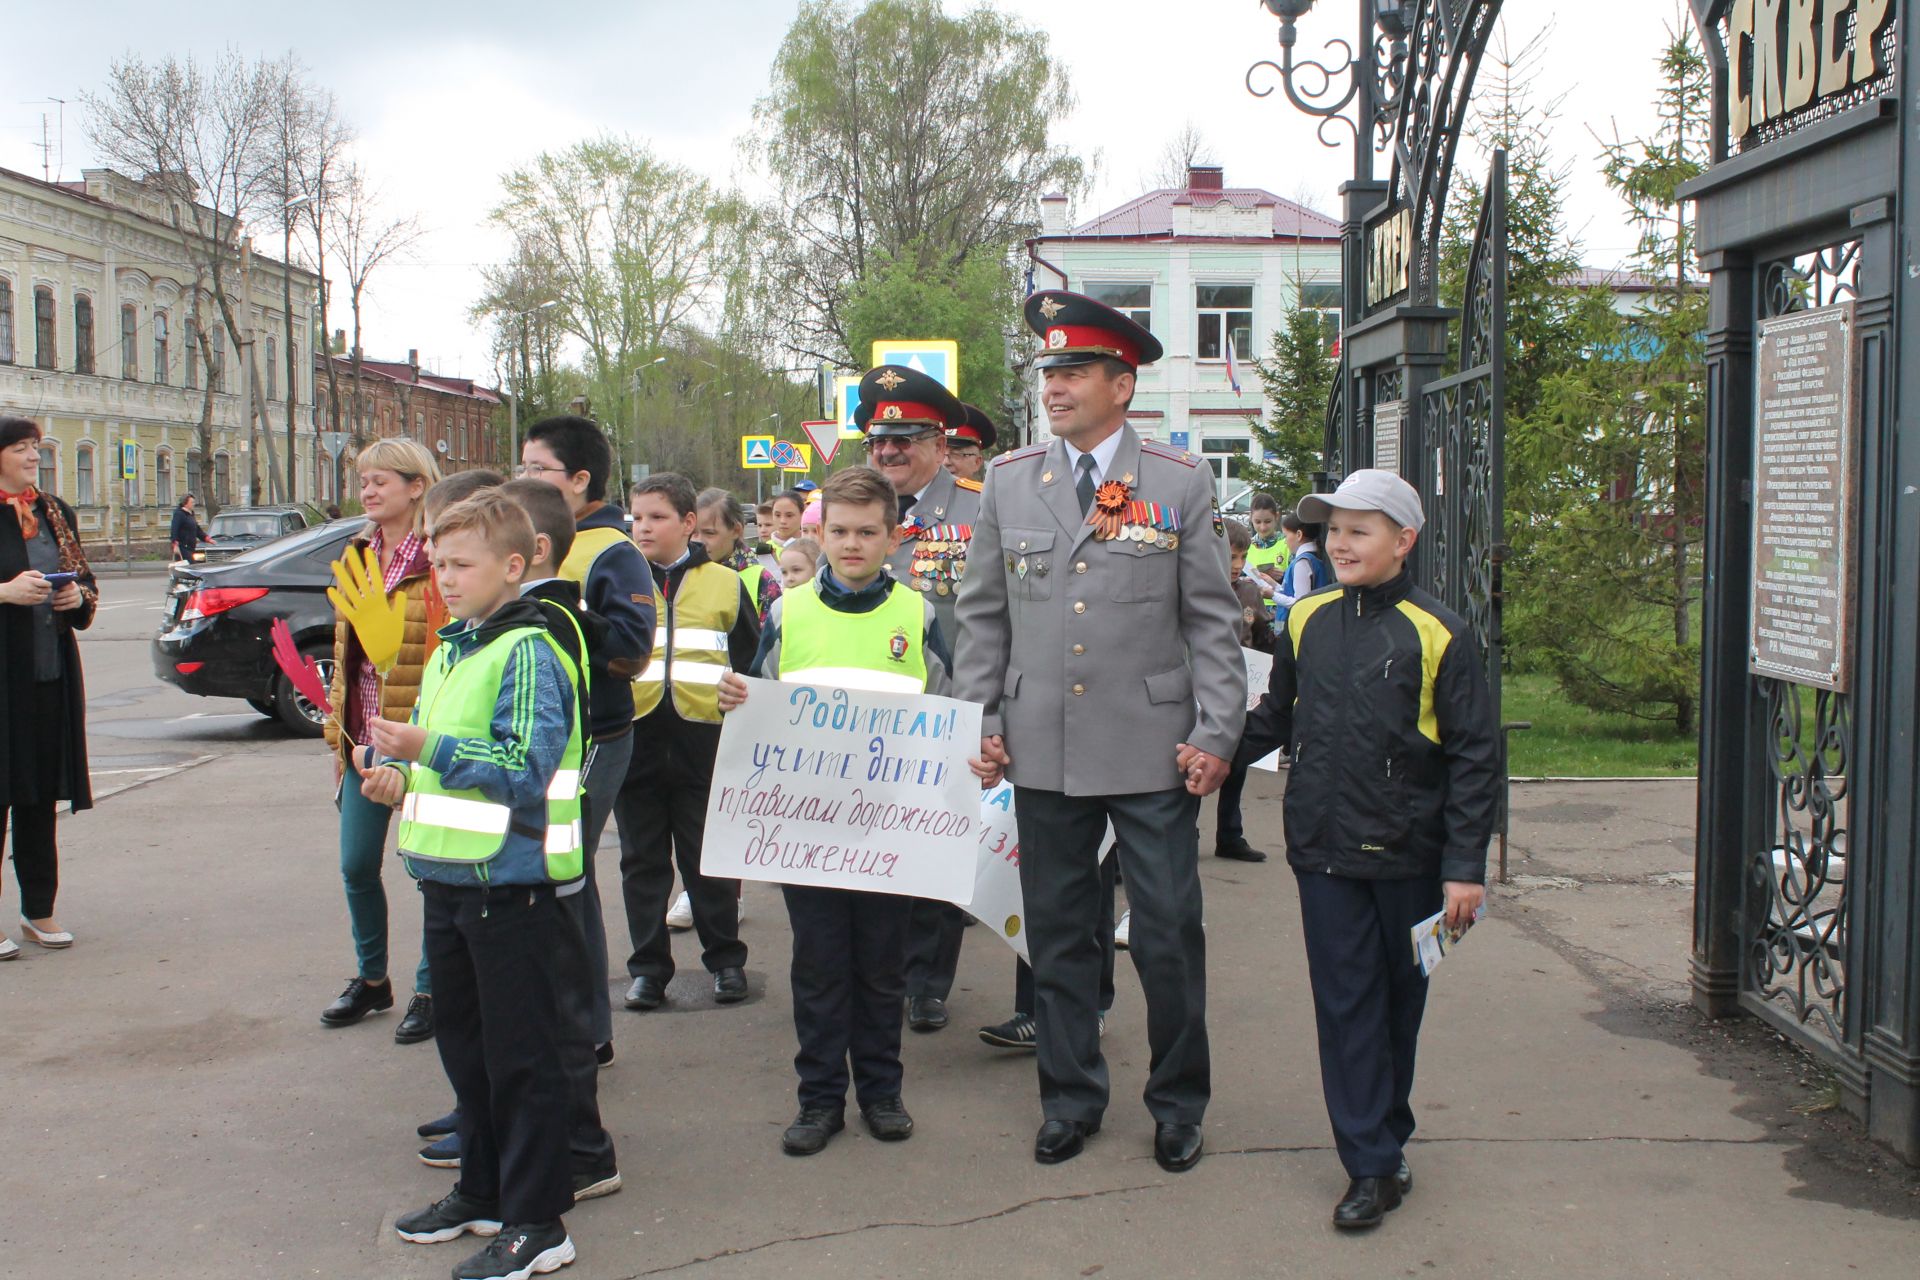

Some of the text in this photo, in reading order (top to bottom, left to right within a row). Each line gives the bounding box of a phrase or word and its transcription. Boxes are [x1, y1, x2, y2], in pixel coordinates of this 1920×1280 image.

[1367, 208, 1410, 307] СКВЕР
[789, 687, 957, 741] Родители!
[745, 736, 950, 789] учите детей
[717, 787, 970, 839] правилам дорожного
[744, 819, 904, 878] движения
[511, 1235, 528, 1254] FILA
